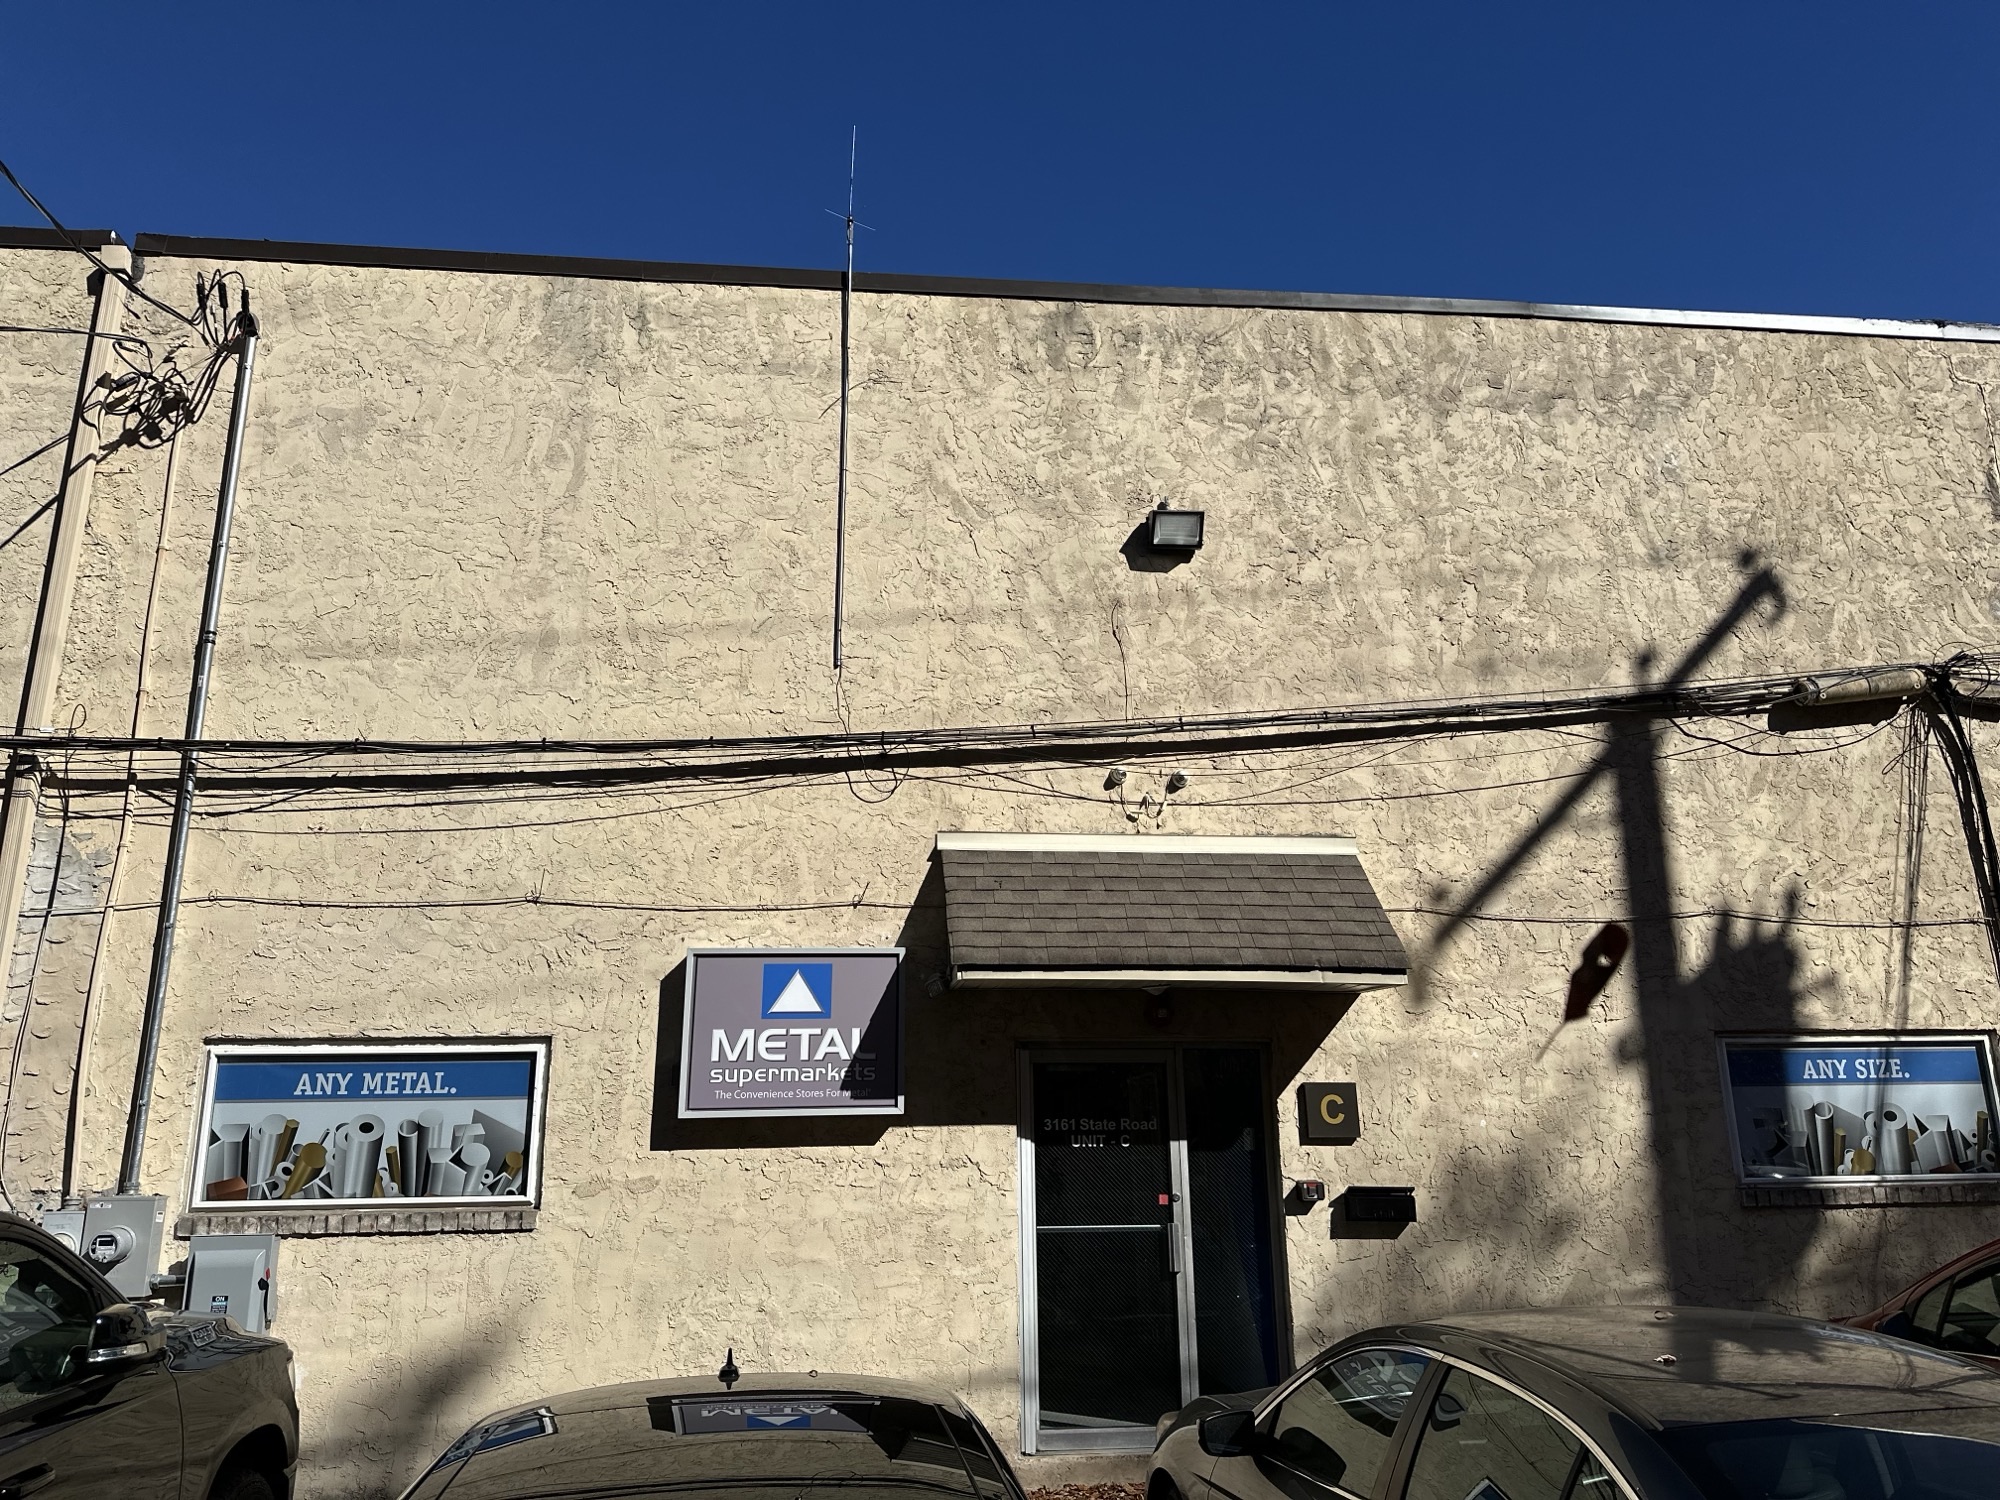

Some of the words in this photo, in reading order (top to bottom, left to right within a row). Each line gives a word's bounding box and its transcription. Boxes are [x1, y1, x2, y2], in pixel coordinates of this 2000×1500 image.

[710, 1027, 877, 1062] METAL
[709, 1063, 876, 1087] supermarkets
[1803, 1058, 1847, 1079] ANY
[1855, 1058, 1910, 1079] SIZE.
[293, 1072, 353, 1096] ANY
[360, 1071, 457, 1095] METAL.
[714, 1090, 733, 1099] The
[734, 1089, 794, 1099] Convenience
[795, 1088, 824, 1098] Stores
[826, 1088, 841, 1098] For
[1319, 1093, 1345, 1125] C
[1043, 1118, 1076, 1131] 3161
[1079, 1117, 1117, 1131] State
[1120, 1117, 1158, 1131] Road
[1070, 1134, 1106, 1148] UNIT
[1120, 1134, 1131, 1148] C
